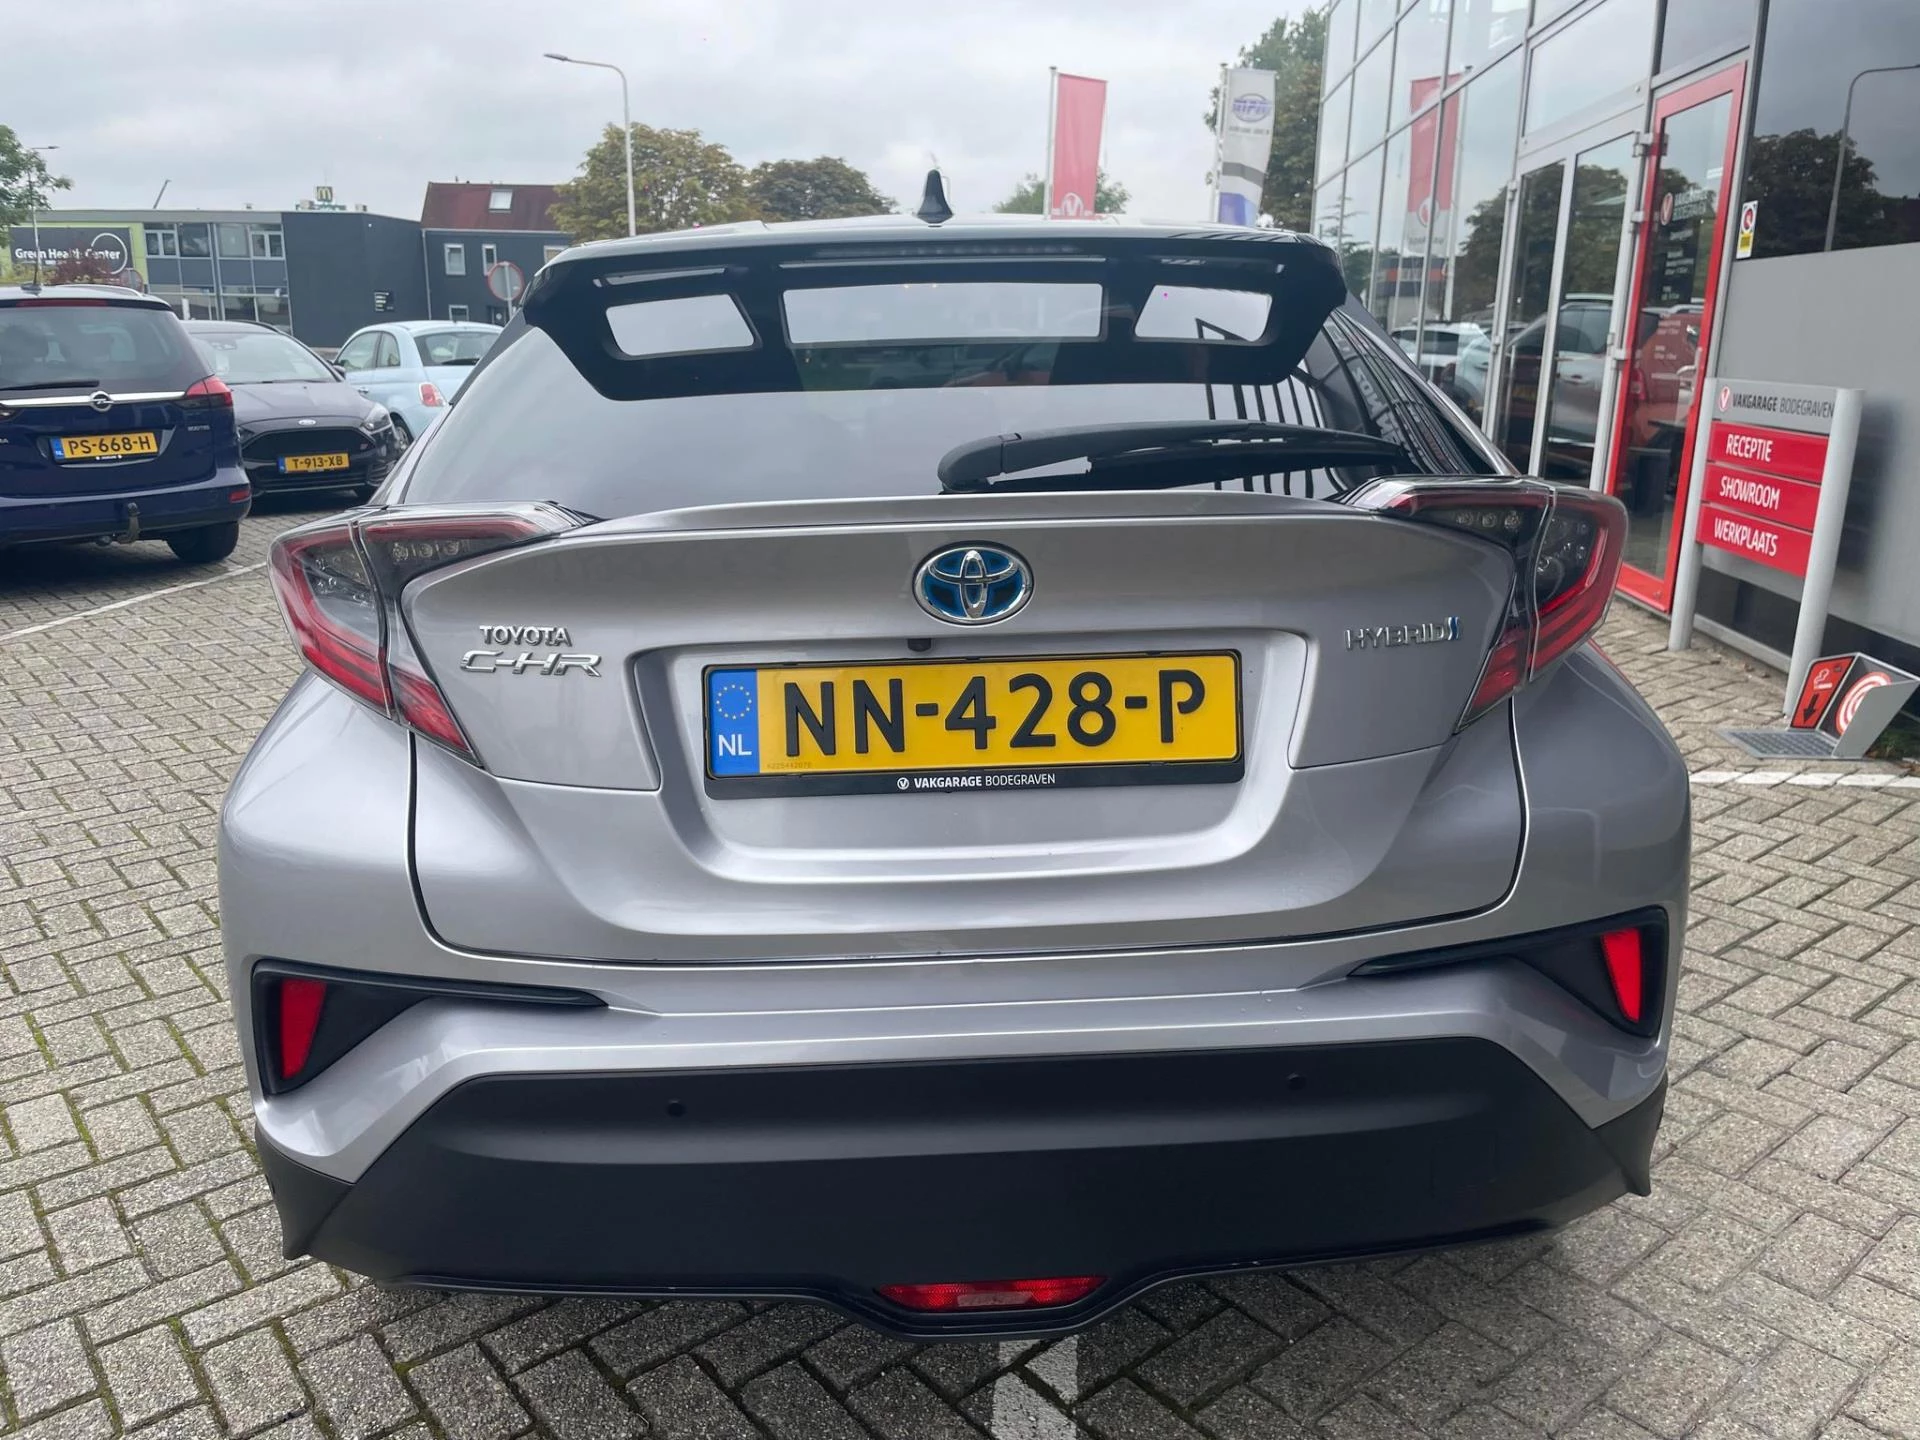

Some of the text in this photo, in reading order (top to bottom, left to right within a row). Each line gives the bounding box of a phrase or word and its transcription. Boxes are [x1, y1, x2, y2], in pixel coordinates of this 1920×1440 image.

[48, 248, 82, 259] Heat
[1732, 393, 1778, 412] VAKGARAGE
[1779, 398, 1835, 418] BODEGRAVEN
[68, 435, 151, 455] PS-668-H
[1726, 433, 1773, 462] RECEPTIE
[292, 455, 343, 469] T-913-XB
[1719, 475, 1780, 510] SHOWROOM
[1714, 517, 1779, 557] WERKPLAATS
[479, 625, 572, 647] TOYOTA
[1344, 622, 1446, 651] HYBRID
[460, 650, 602, 677] C-HR
[784, 668, 1206, 757] NN-428-P
[718, 733, 753, 757] NL
[913, 776, 982, 788] VAKGARAGE
[985, 773, 1056, 787] BODEGRAVEN
